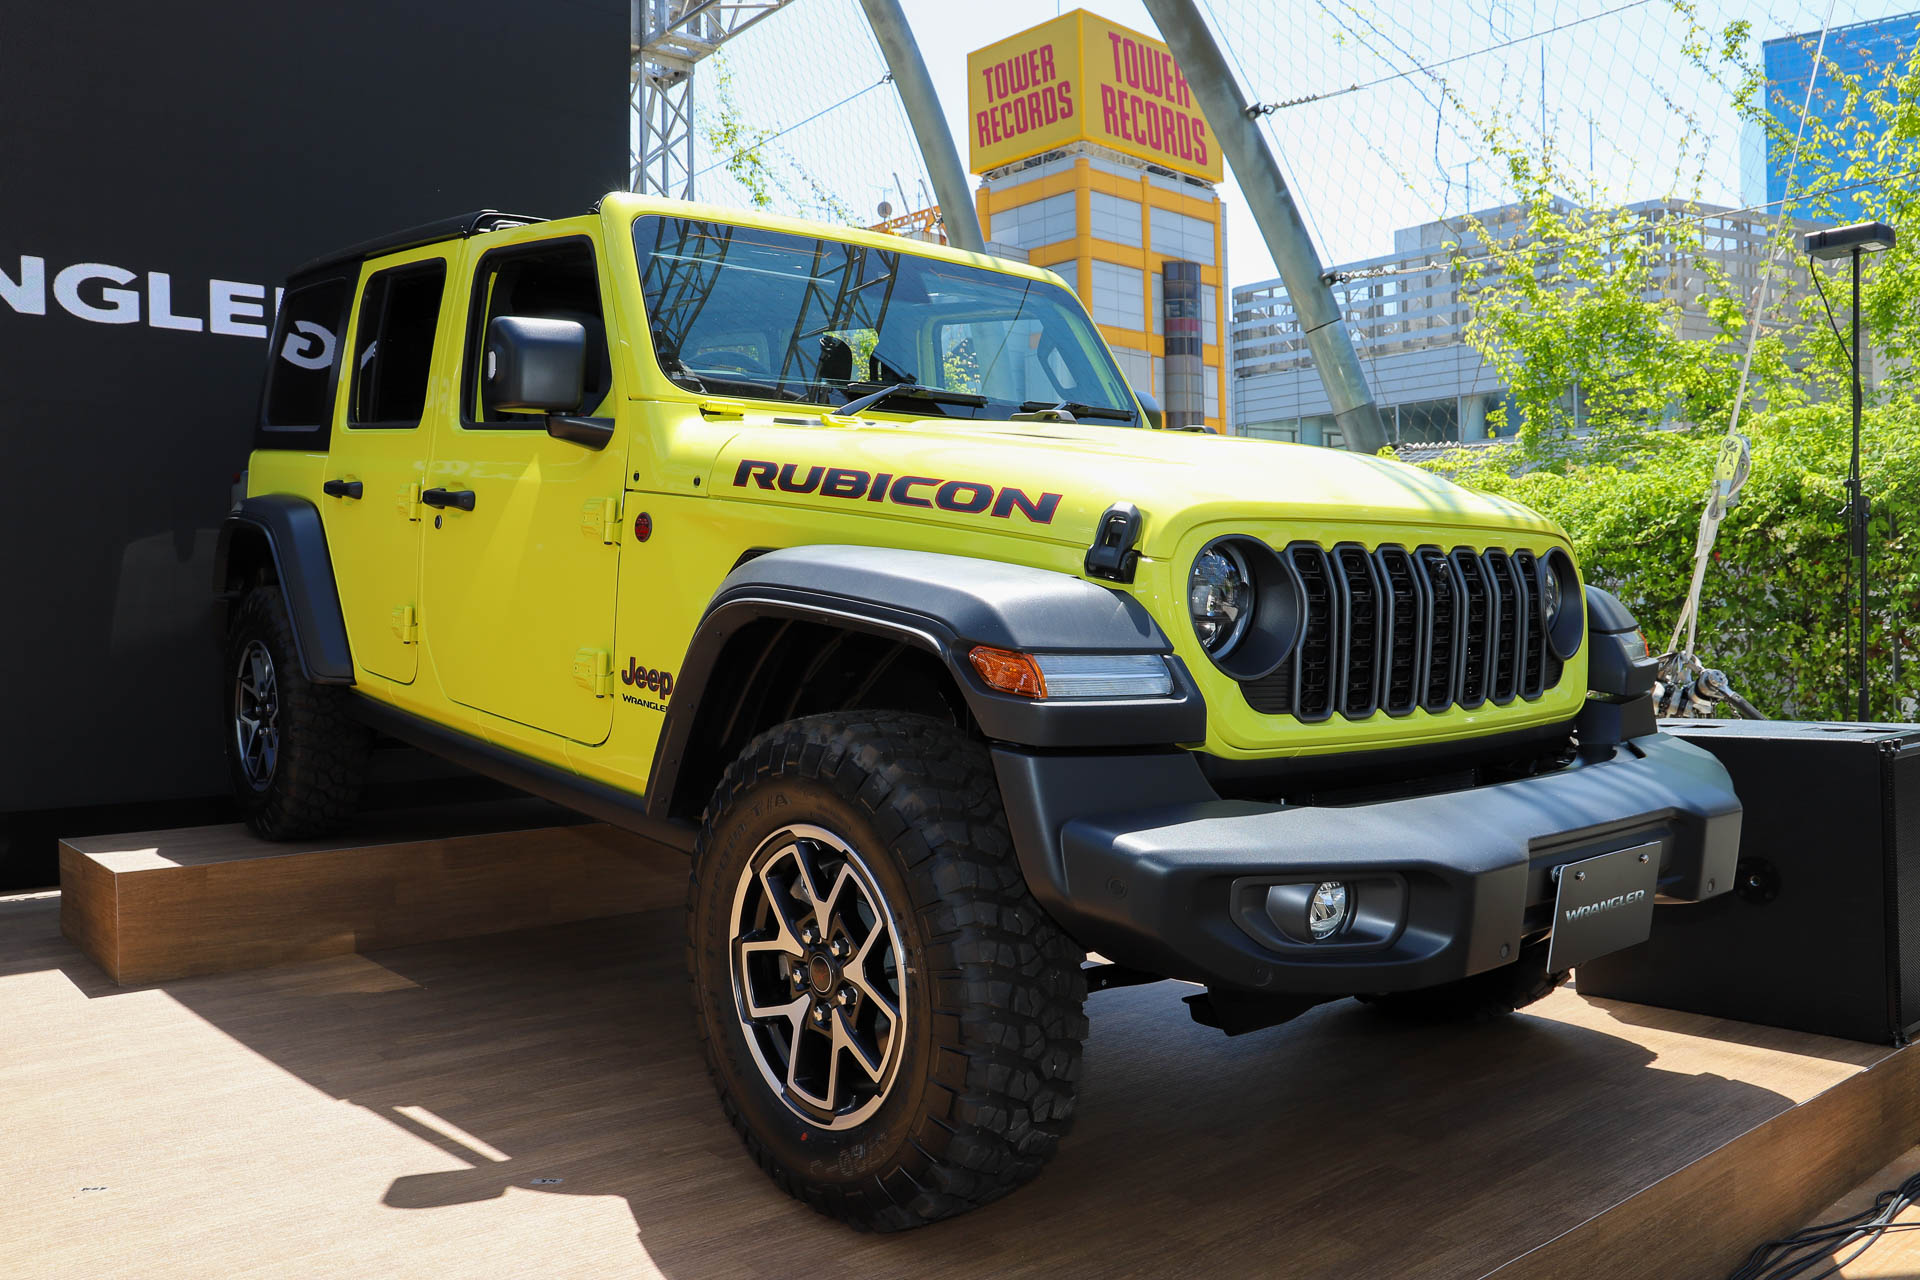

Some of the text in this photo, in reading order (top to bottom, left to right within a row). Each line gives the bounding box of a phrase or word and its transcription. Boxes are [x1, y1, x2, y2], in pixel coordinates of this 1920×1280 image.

[982, 44, 1057, 103] TOWER
[1108, 31, 1191, 108] TOWER
[976, 80, 1074, 148] RECORDS
[1100, 83, 1208, 166] RECORDS
[0, 255, 284, 339] NGLE
[733, 459, 1063, 525] RUBICON
[621, 656, 673, 700] Jeep
[1565, 889, 1645, 922] WRANGLER
